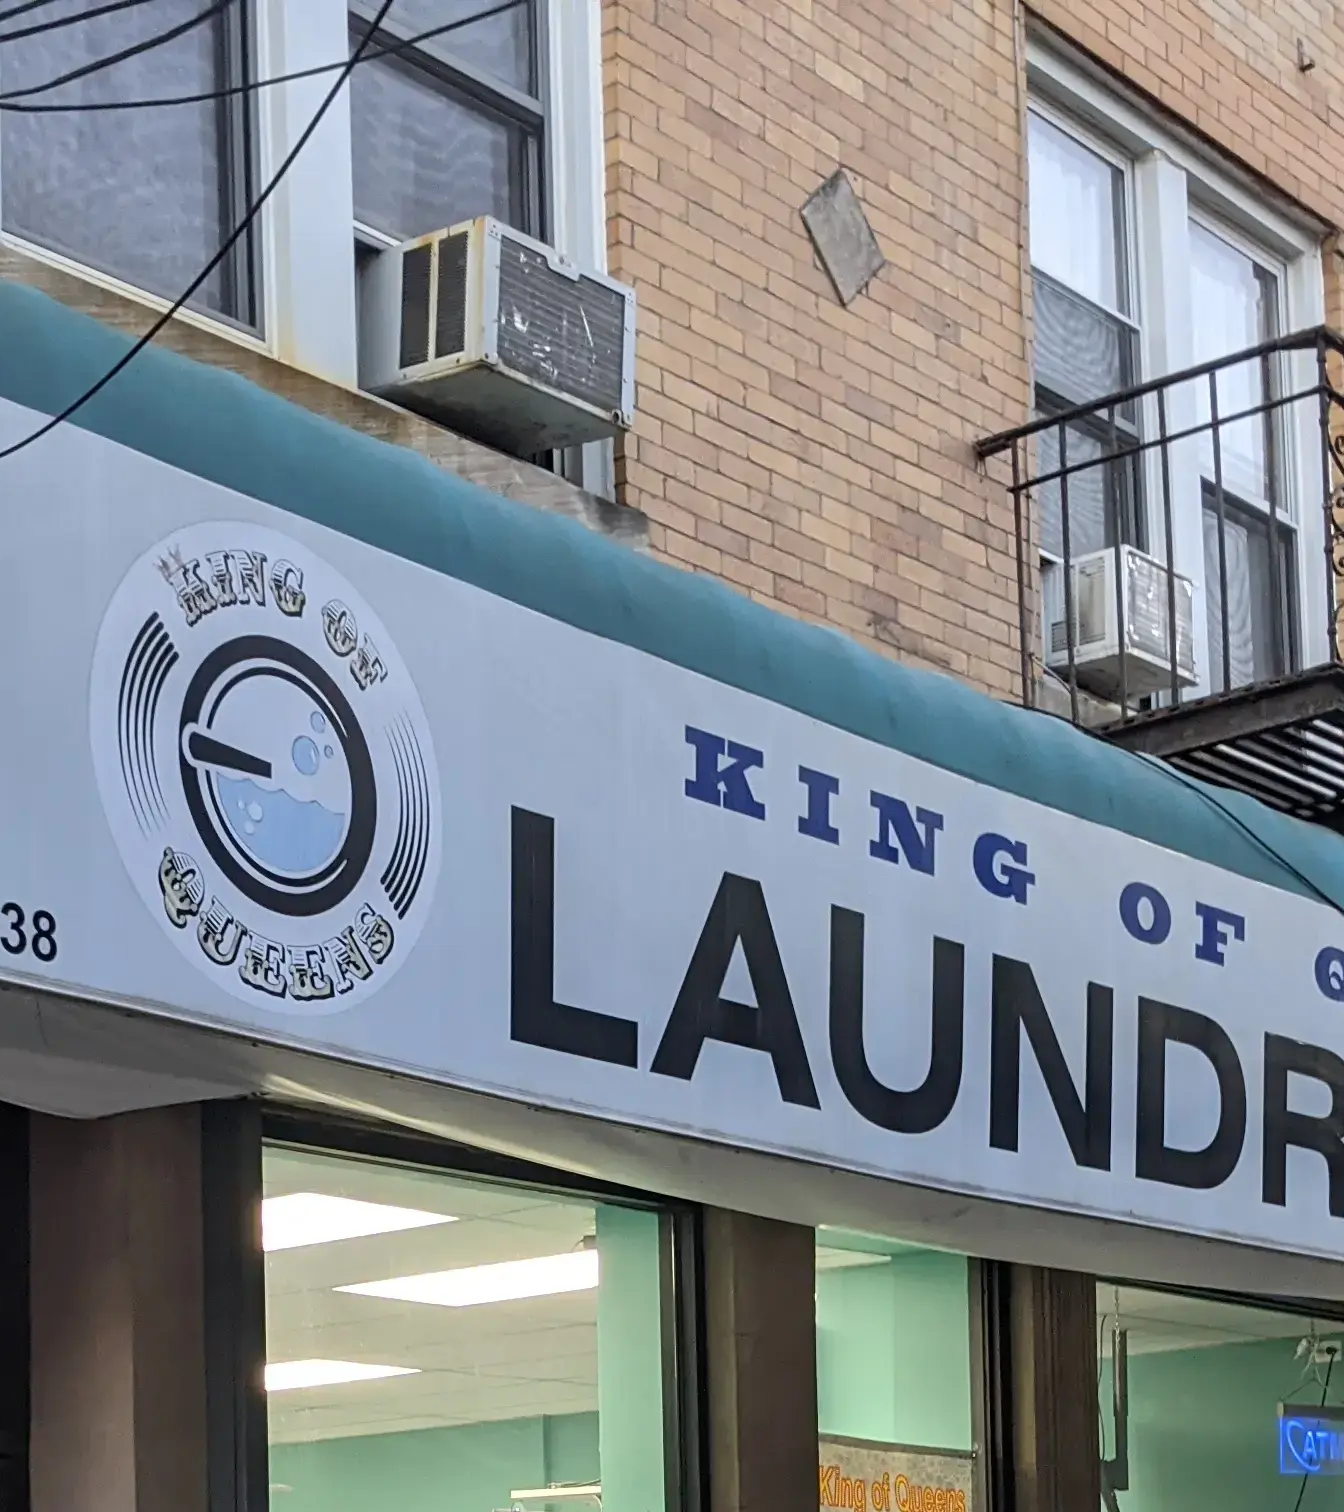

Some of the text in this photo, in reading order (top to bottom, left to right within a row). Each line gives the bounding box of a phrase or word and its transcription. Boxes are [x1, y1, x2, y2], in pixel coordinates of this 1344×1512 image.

[173, 547, 387, 691] KING OF
[683, 725, 1037, 905] KING
[1119, 880, 1246, 967] OF
[158, 844, 395, 1002] QUEENS
[871, 1472, 891, 1512] of
